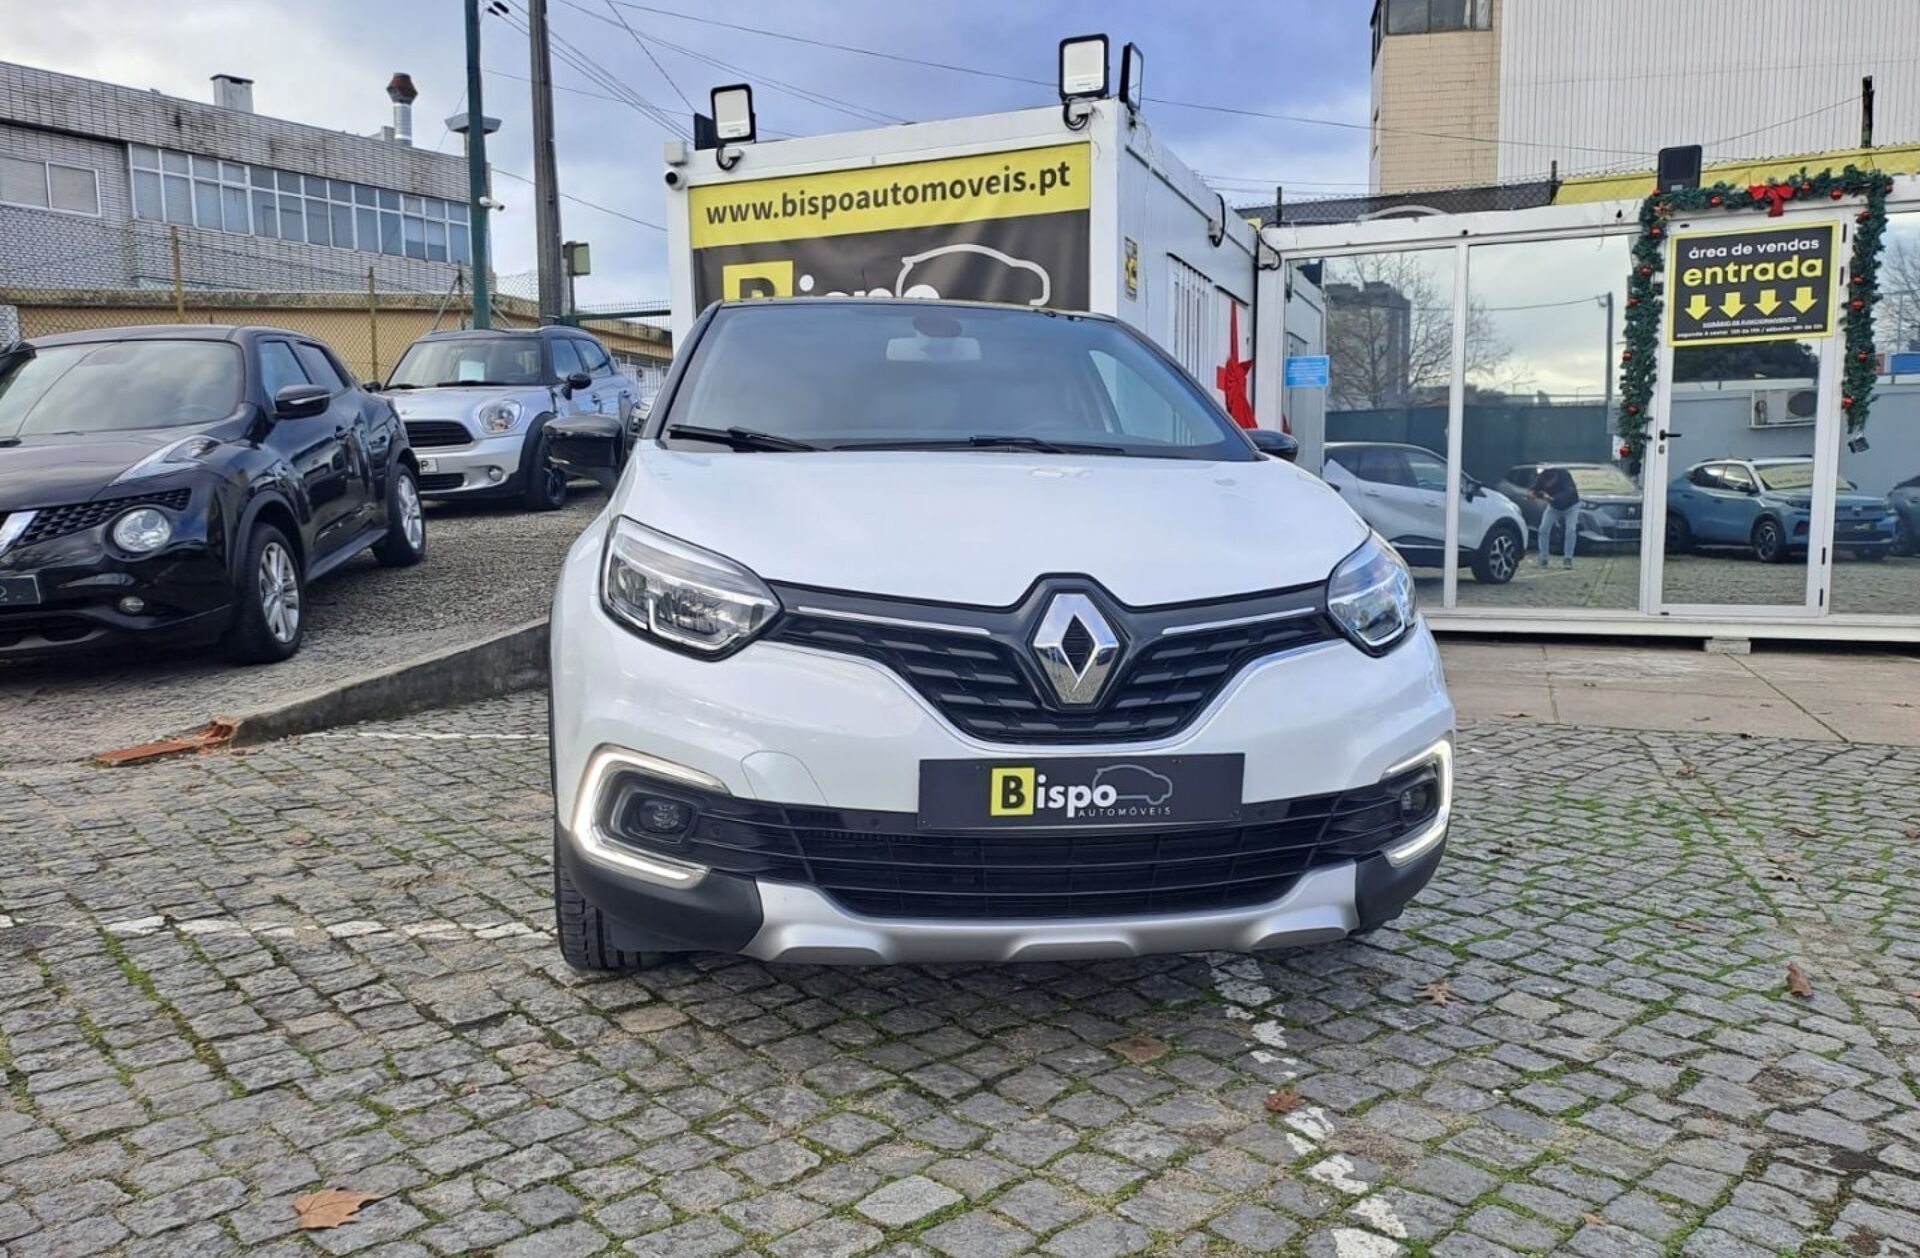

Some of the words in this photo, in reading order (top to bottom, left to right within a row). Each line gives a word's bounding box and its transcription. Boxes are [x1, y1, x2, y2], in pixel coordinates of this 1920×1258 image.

[706, 161, 1071, 225] www.bispoautomoveis.pt
[1688, 246, 1727, 259] área
[1731, 243, 1753, 256] de
[1757, 238, 1820, 253] vendas
[1682, 254, 1823, 287] entrada
[1001, 774, 1117, 818] Bispo
[1078, 805, 1171, 818] AUTOMÓVEIS
